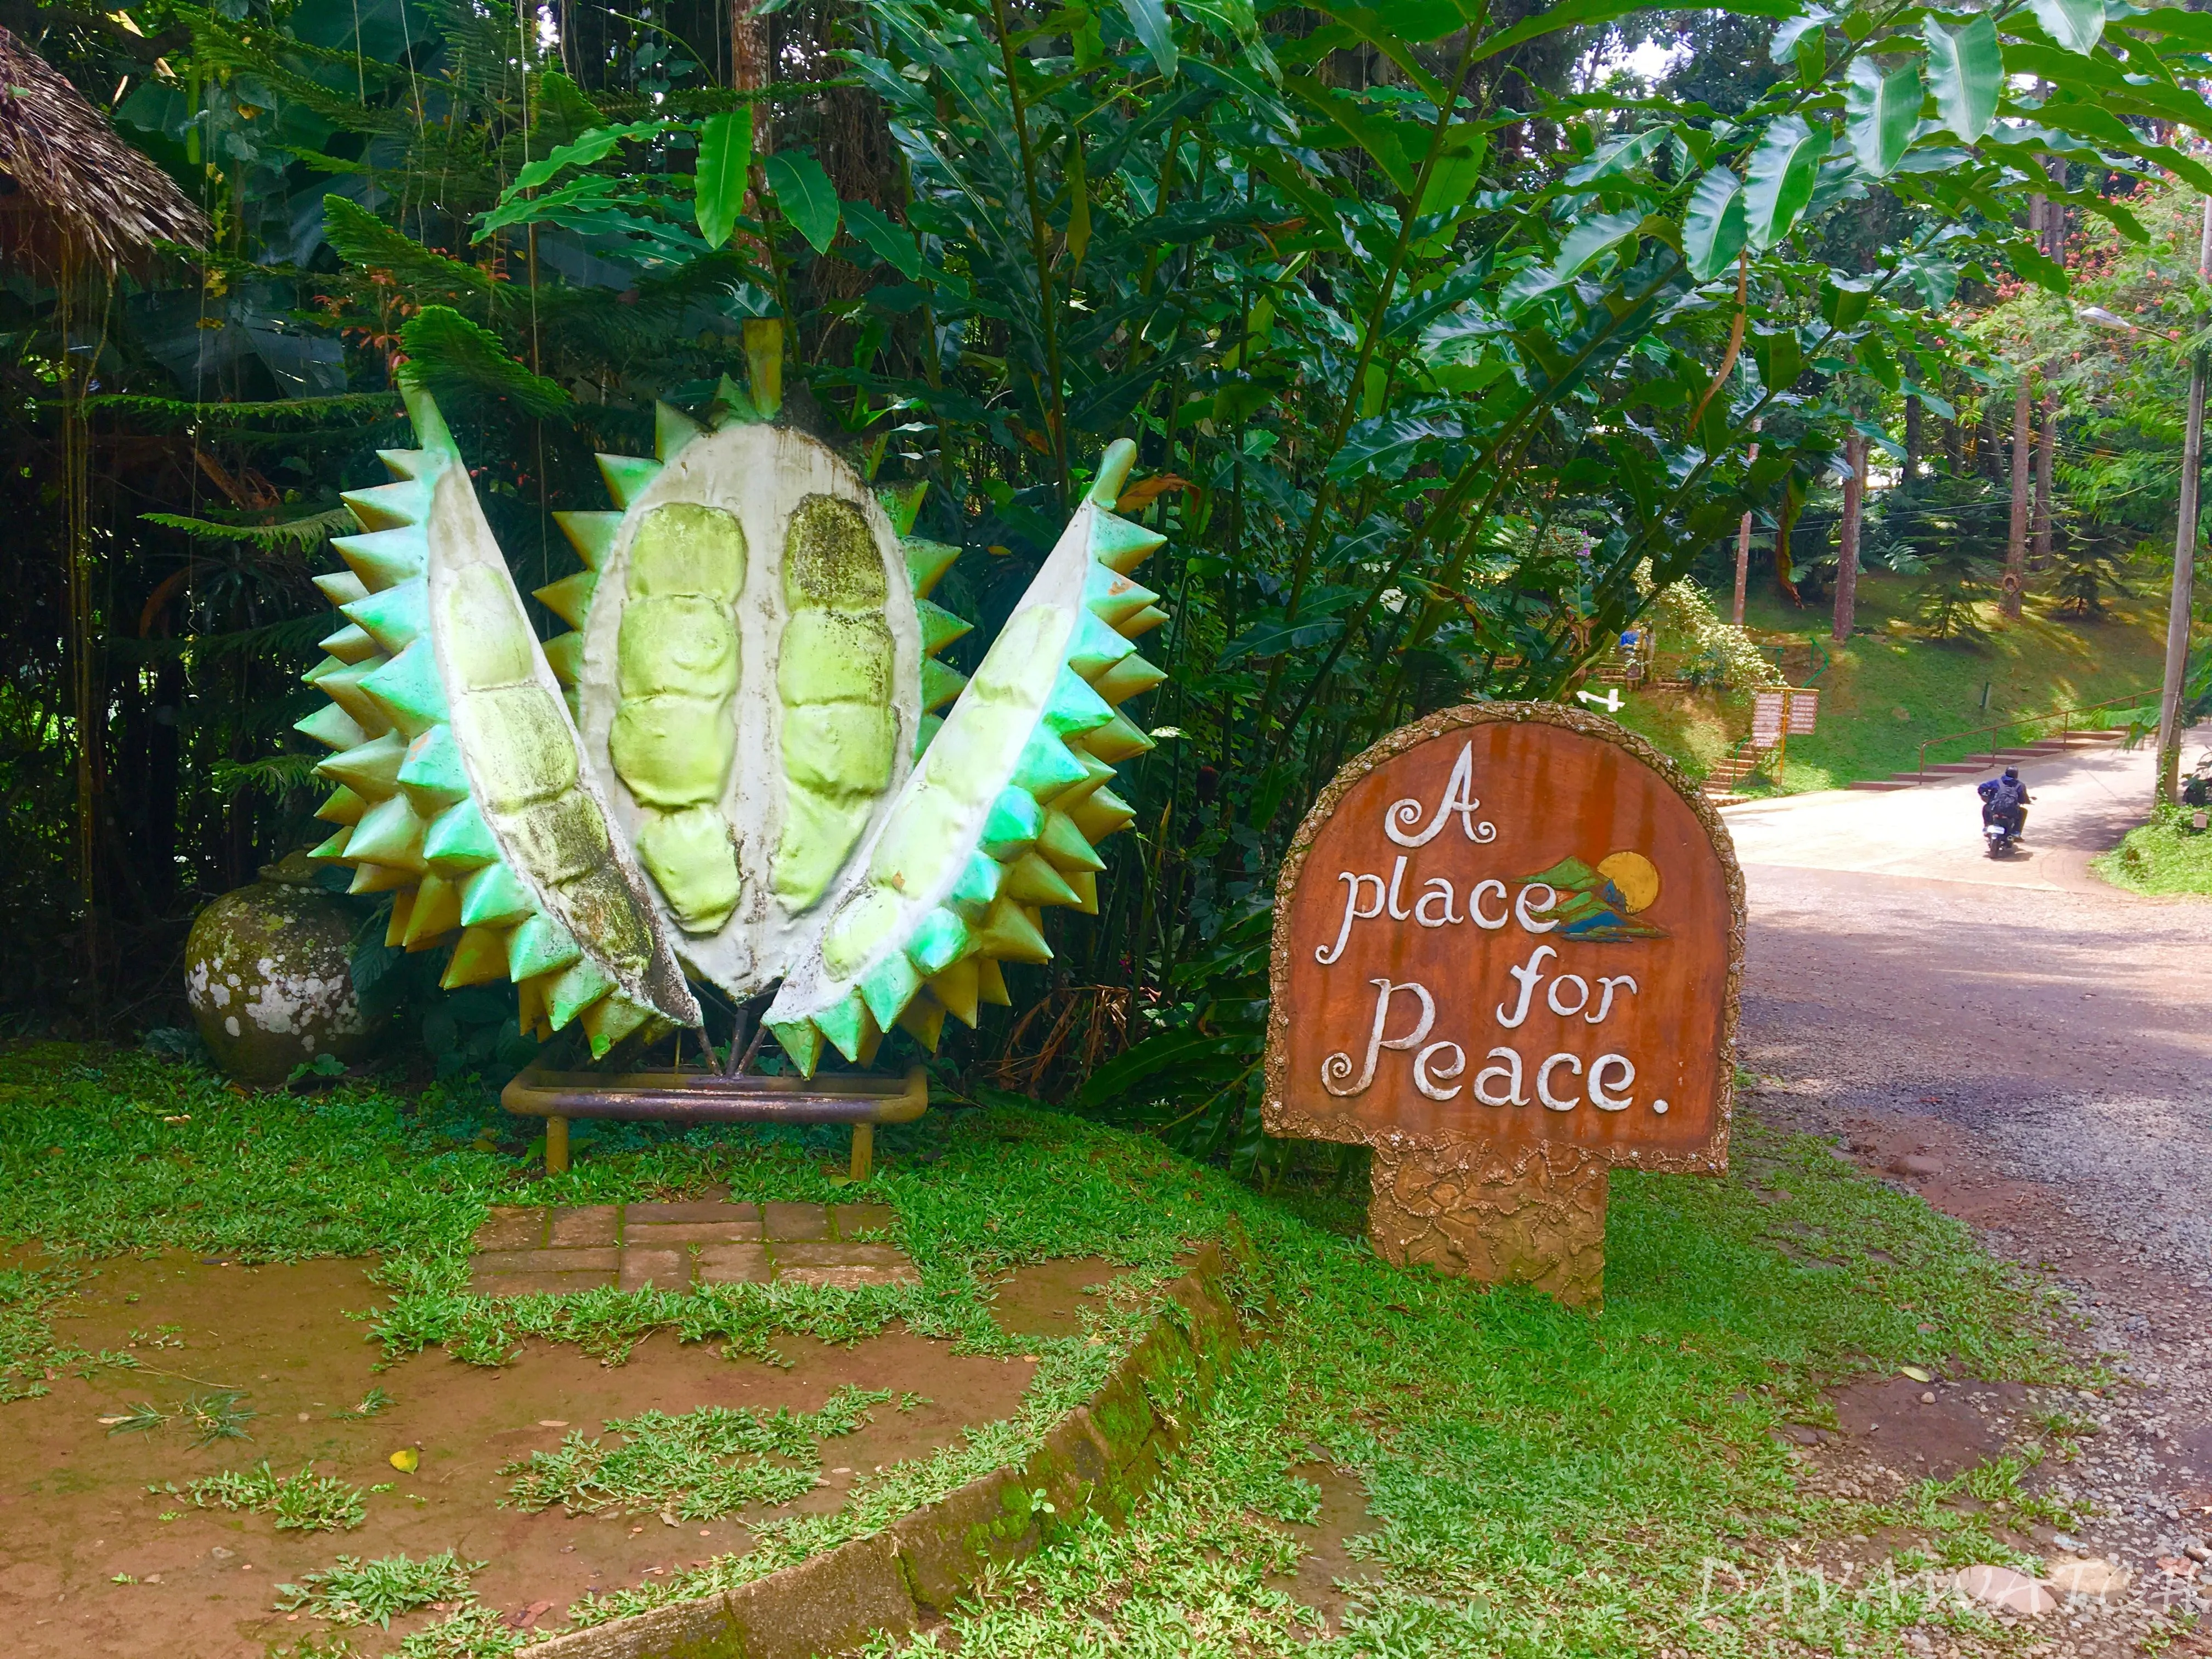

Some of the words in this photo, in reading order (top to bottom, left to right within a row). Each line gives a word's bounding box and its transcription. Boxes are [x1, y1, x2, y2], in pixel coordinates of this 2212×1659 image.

[1385, 740, 1497, 848] A
[1316, 855, 1561, 965] place
[1497, 945, 1637, 1029] for
[1322, 979, 1669, 1114] Peace.
